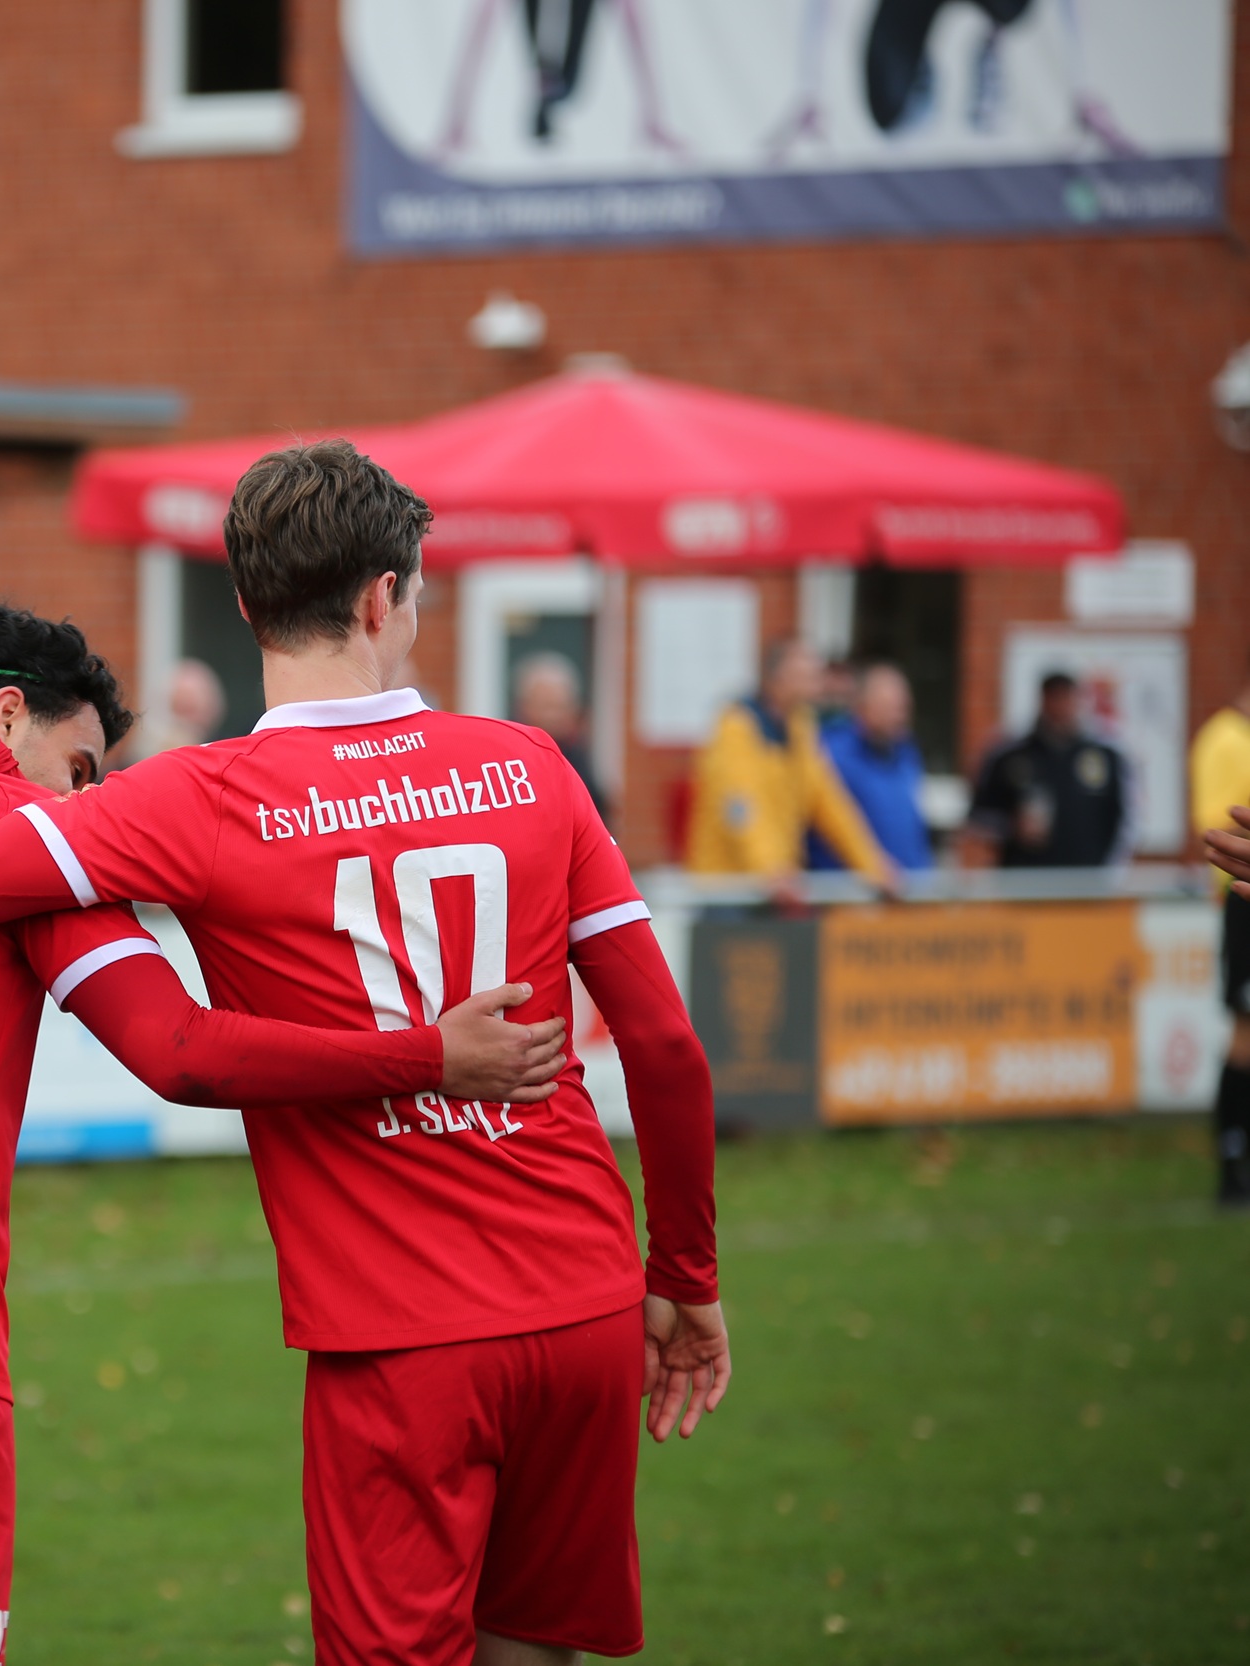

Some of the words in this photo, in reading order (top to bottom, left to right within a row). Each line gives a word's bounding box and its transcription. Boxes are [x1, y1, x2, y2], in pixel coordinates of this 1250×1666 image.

[333, 731, 427, 761] #NULLACHT
[256, 759, 537, 842] tsvbuchholz08
[333, 843, 508, 1032] 10
[376, 1096, 412, 1138] J.
